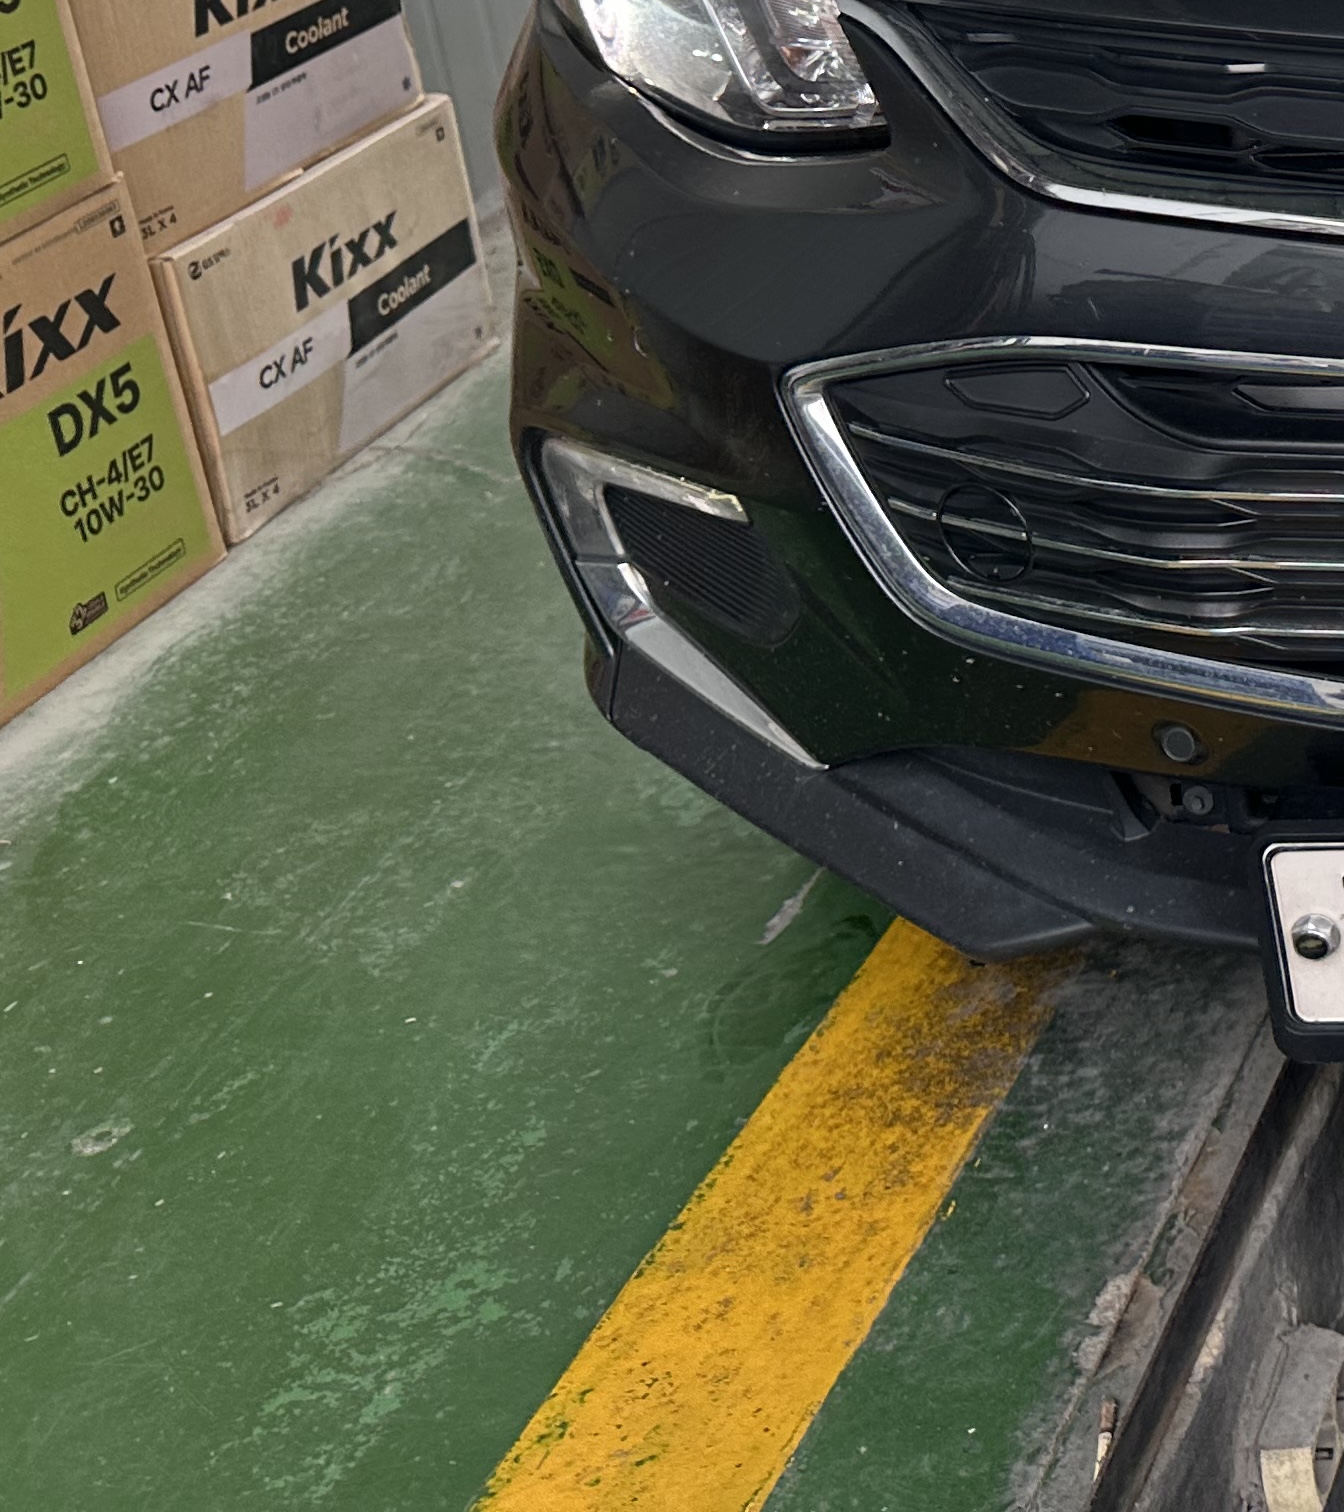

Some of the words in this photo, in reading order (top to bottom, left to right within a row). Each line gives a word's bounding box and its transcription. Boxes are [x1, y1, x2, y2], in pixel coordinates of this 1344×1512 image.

[285, 7, 350, 54] Coolant
[0, 39, 36, 86] /E7
[150, 79, 180, 113] CX
[185, 65, 211, 99] AF
[0, 73, 48, 120] -30
[291, 210, 399, 313] Kixx
[377, 264, 432, 317] Coolant
[0, 272, 121, 400] ixx
[259, 355, 287, 389] CX
[291, 336, 314, 374] AF
[47, 361, 141, 457] DX5
[59, 433, 154, 517] CH-4/E7
[73, 465, 165, 542] 10W-30
